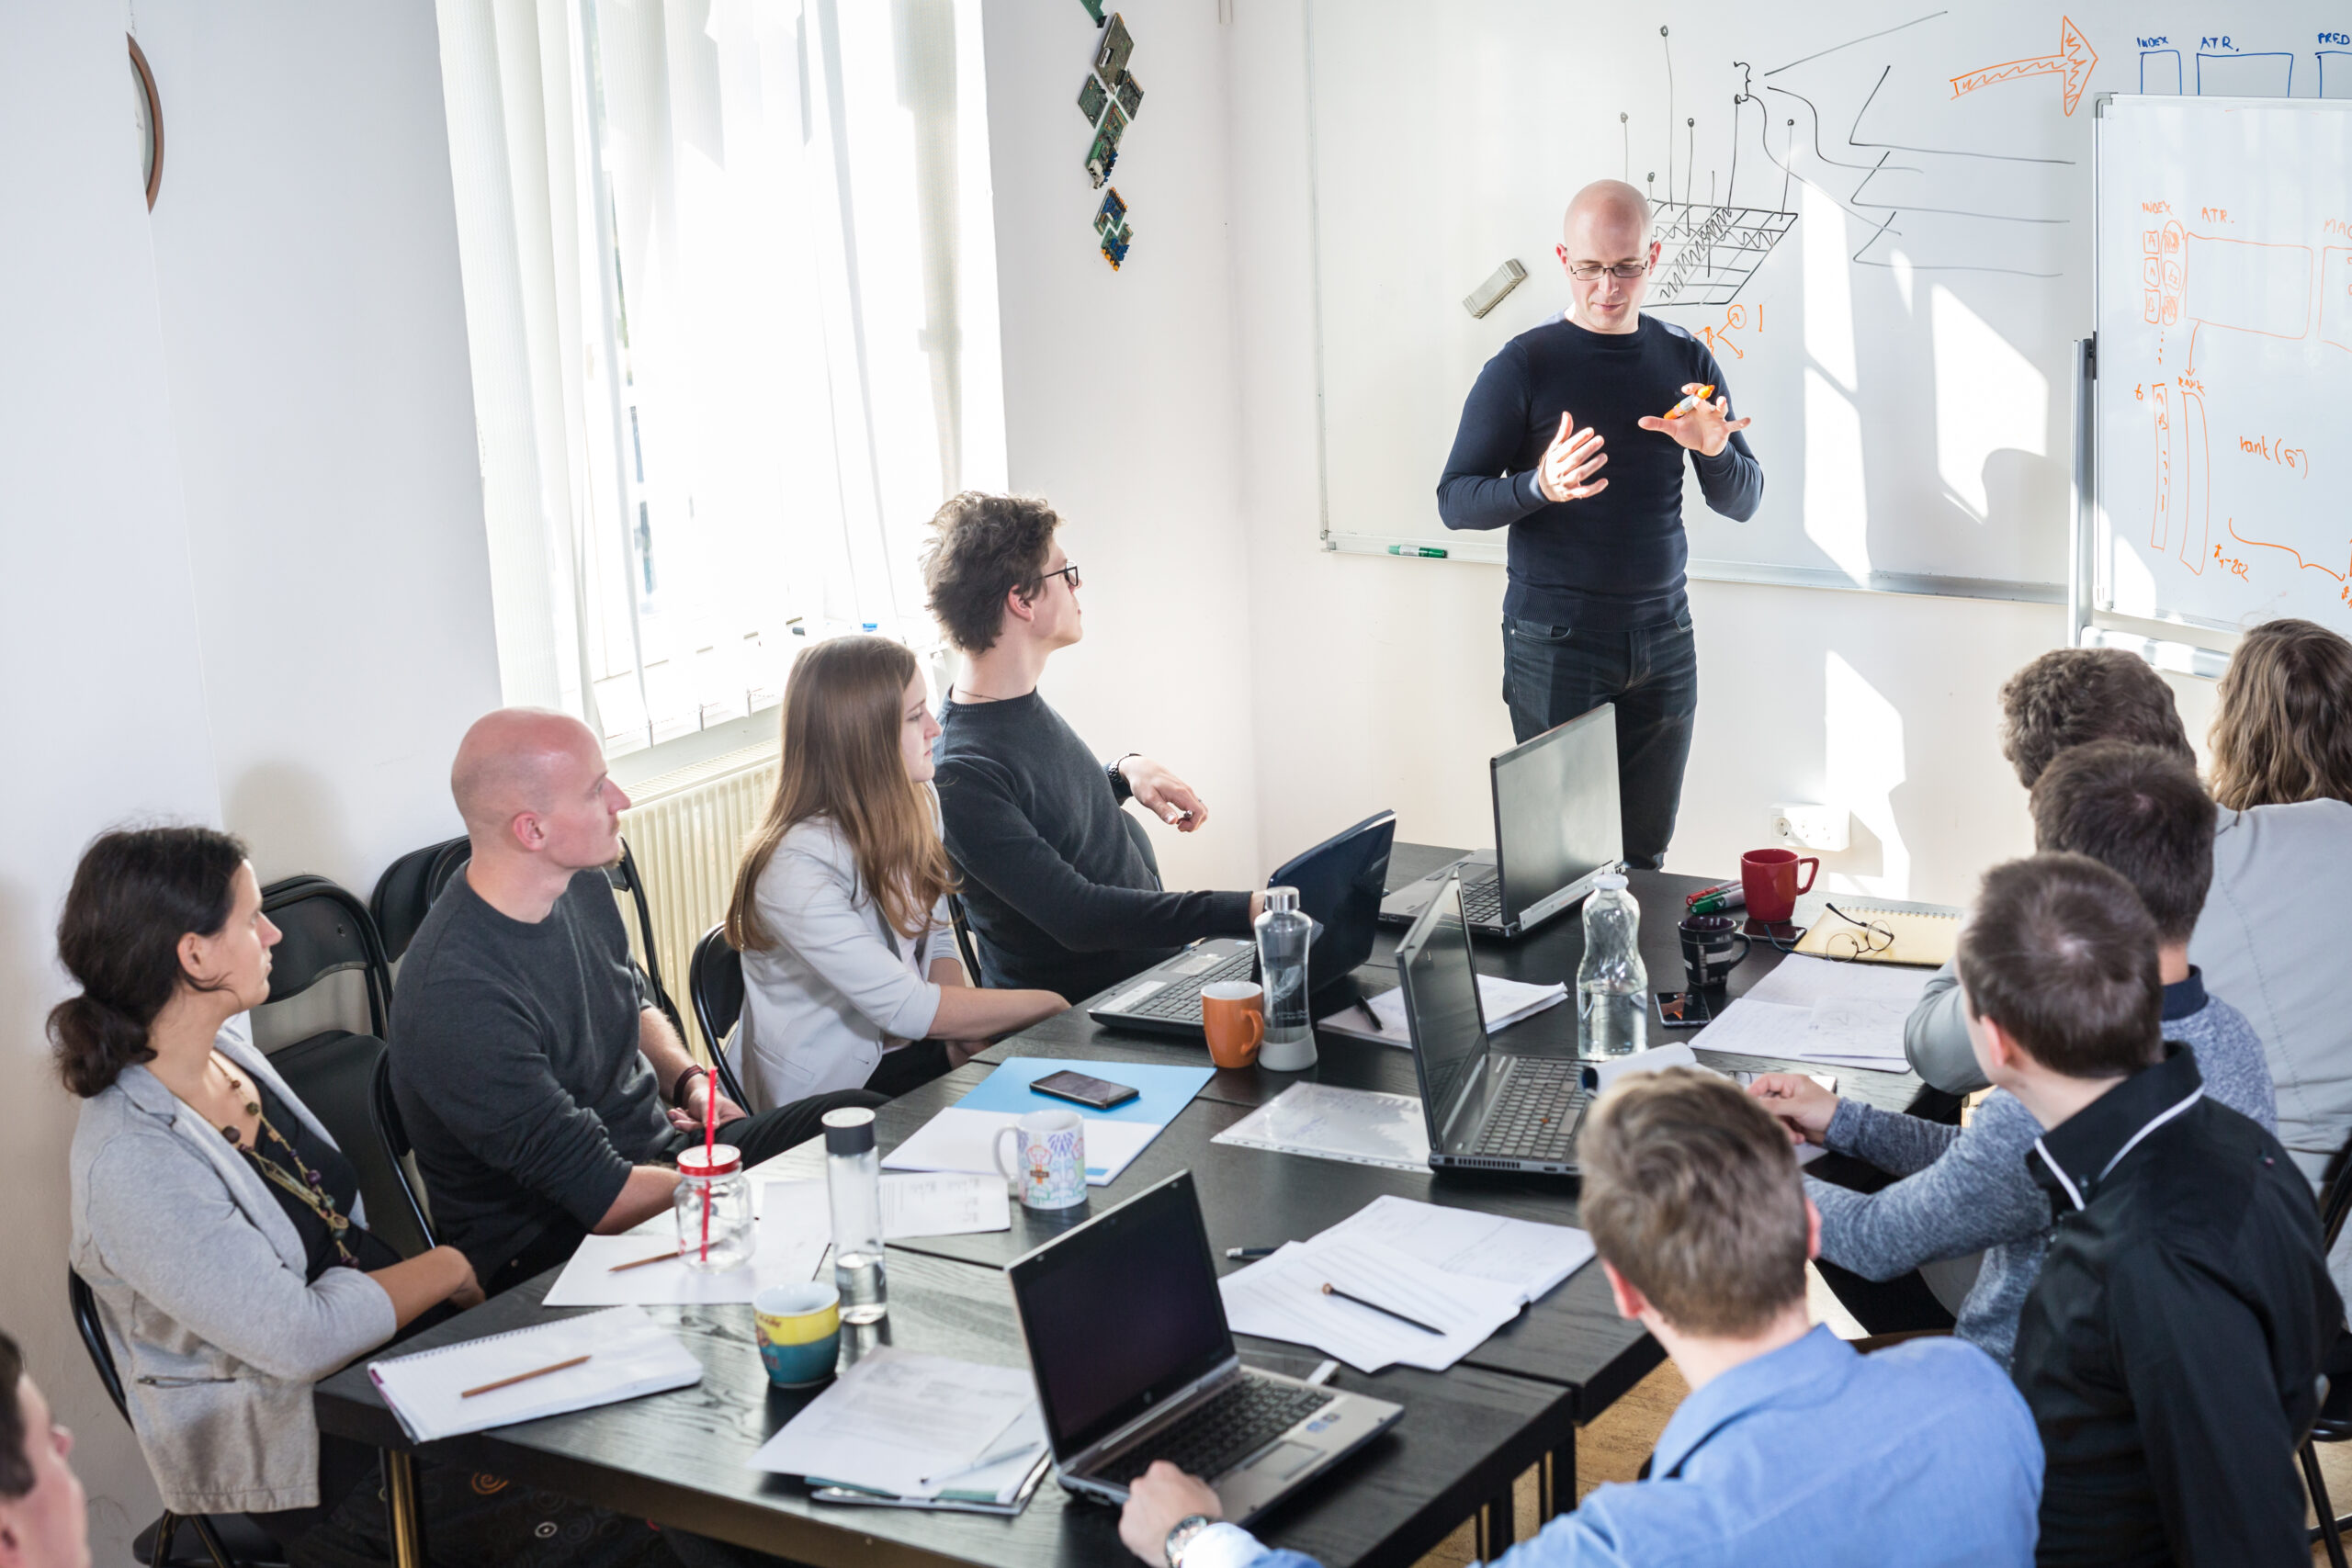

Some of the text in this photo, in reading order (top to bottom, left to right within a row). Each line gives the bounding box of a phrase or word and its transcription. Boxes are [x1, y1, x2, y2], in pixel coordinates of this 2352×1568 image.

[2136, 32, 2351, 52] INDEX ATR. PRED
